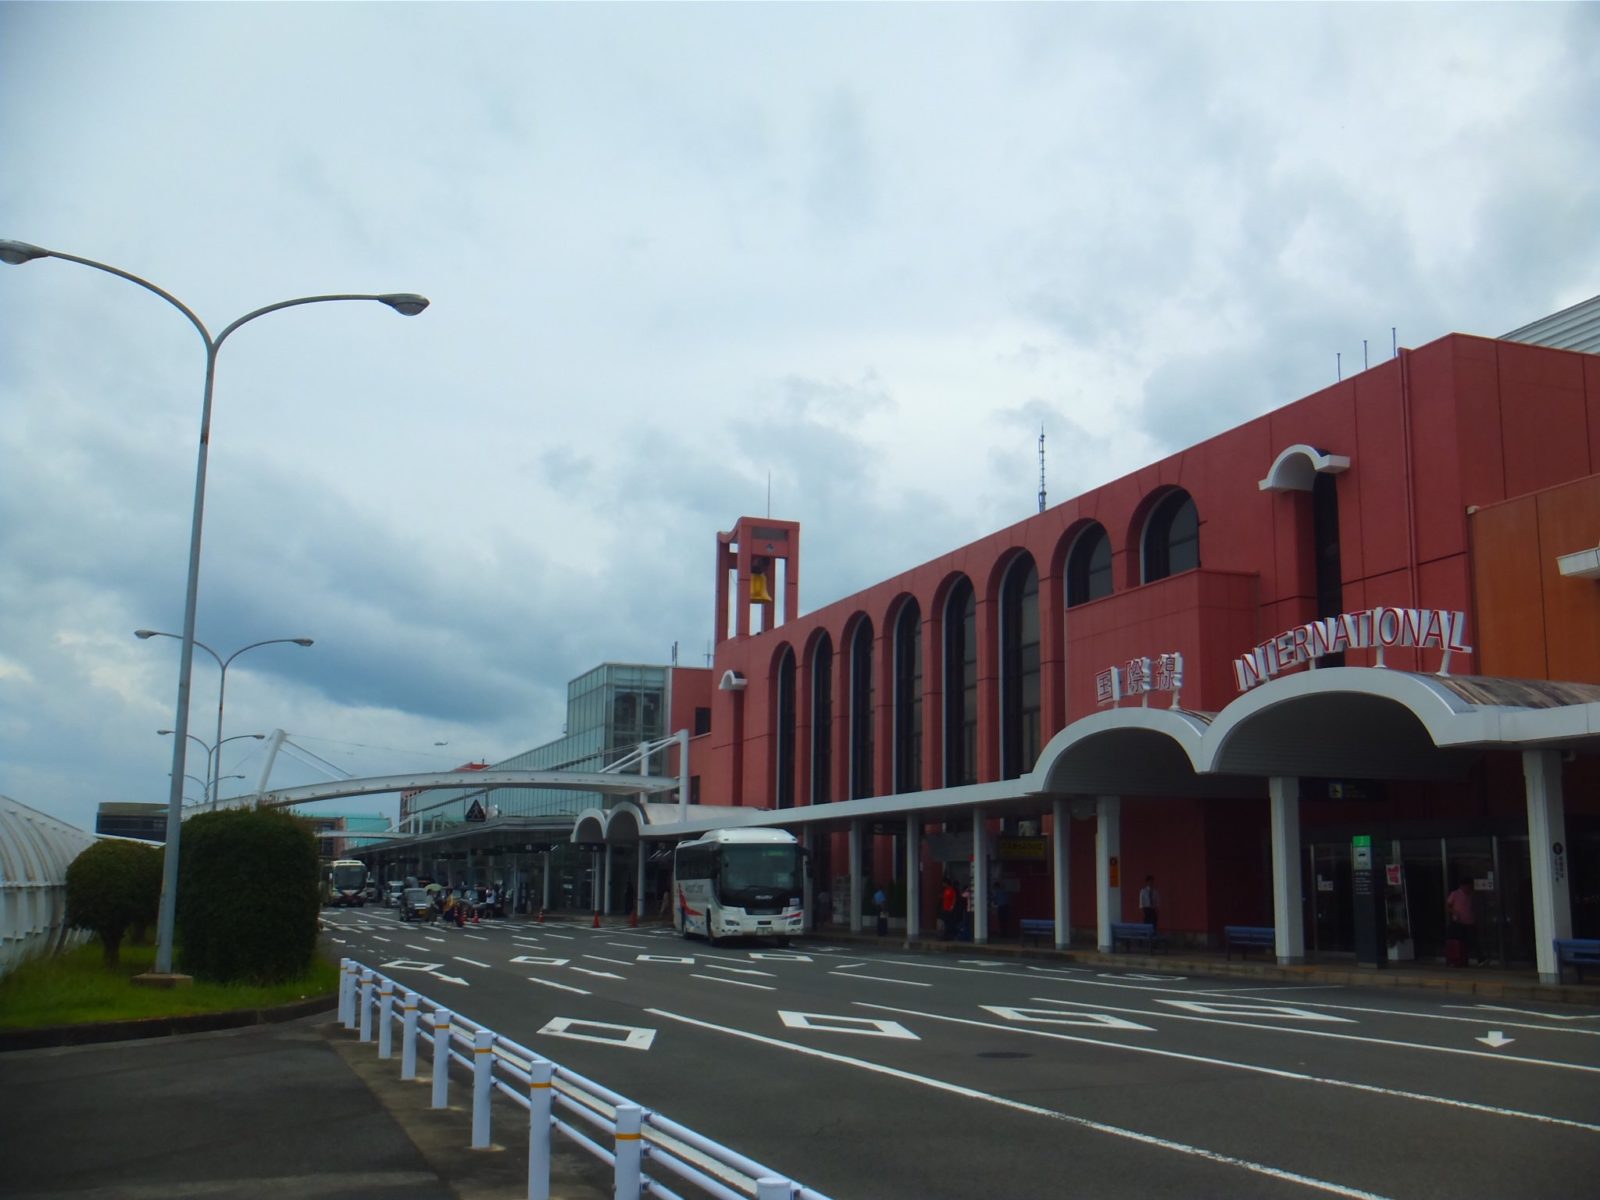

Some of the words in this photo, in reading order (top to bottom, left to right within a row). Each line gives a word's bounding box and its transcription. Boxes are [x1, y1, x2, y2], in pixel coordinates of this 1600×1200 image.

[1096, 653, 1182, 703] 国際線
[1233, 607, 1472, 691] INTERNATIONAL
